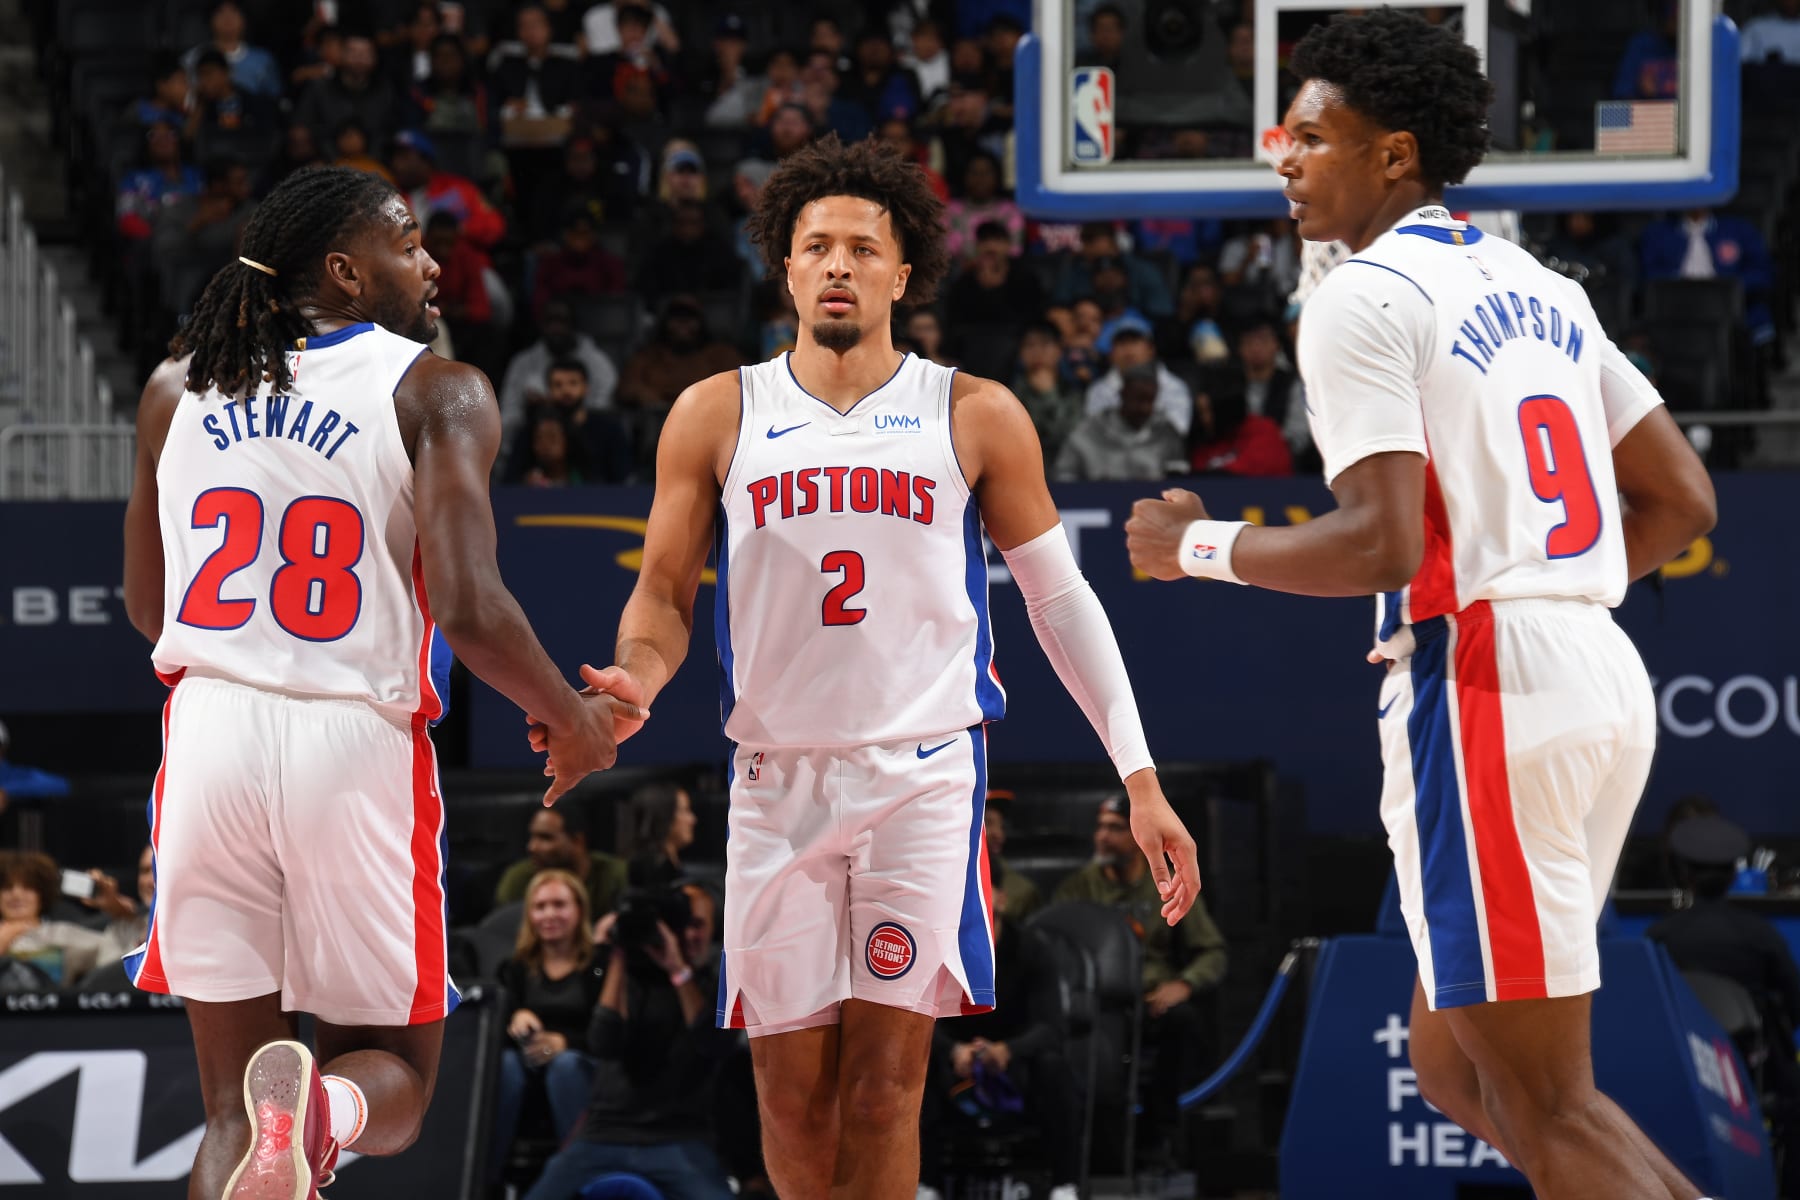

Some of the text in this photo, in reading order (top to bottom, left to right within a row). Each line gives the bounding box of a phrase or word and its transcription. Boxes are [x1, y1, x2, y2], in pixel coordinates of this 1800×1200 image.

[1451, 291, 1584, 376] THOMPSON
[203, 396, 359, 460] STEWART
[874, 414, 921, 429] UWM
[747, 466, 936, 530] PISTONS
[1518, 394, 1603, 560] 9
[176, 486, 365, 642] 28
[820, 549, 867, 626] 2
[12, 586, 125, 625] BE
[873, 948, 904, 964] PISTONS
[875, 938, 906, 954] DETROIT
